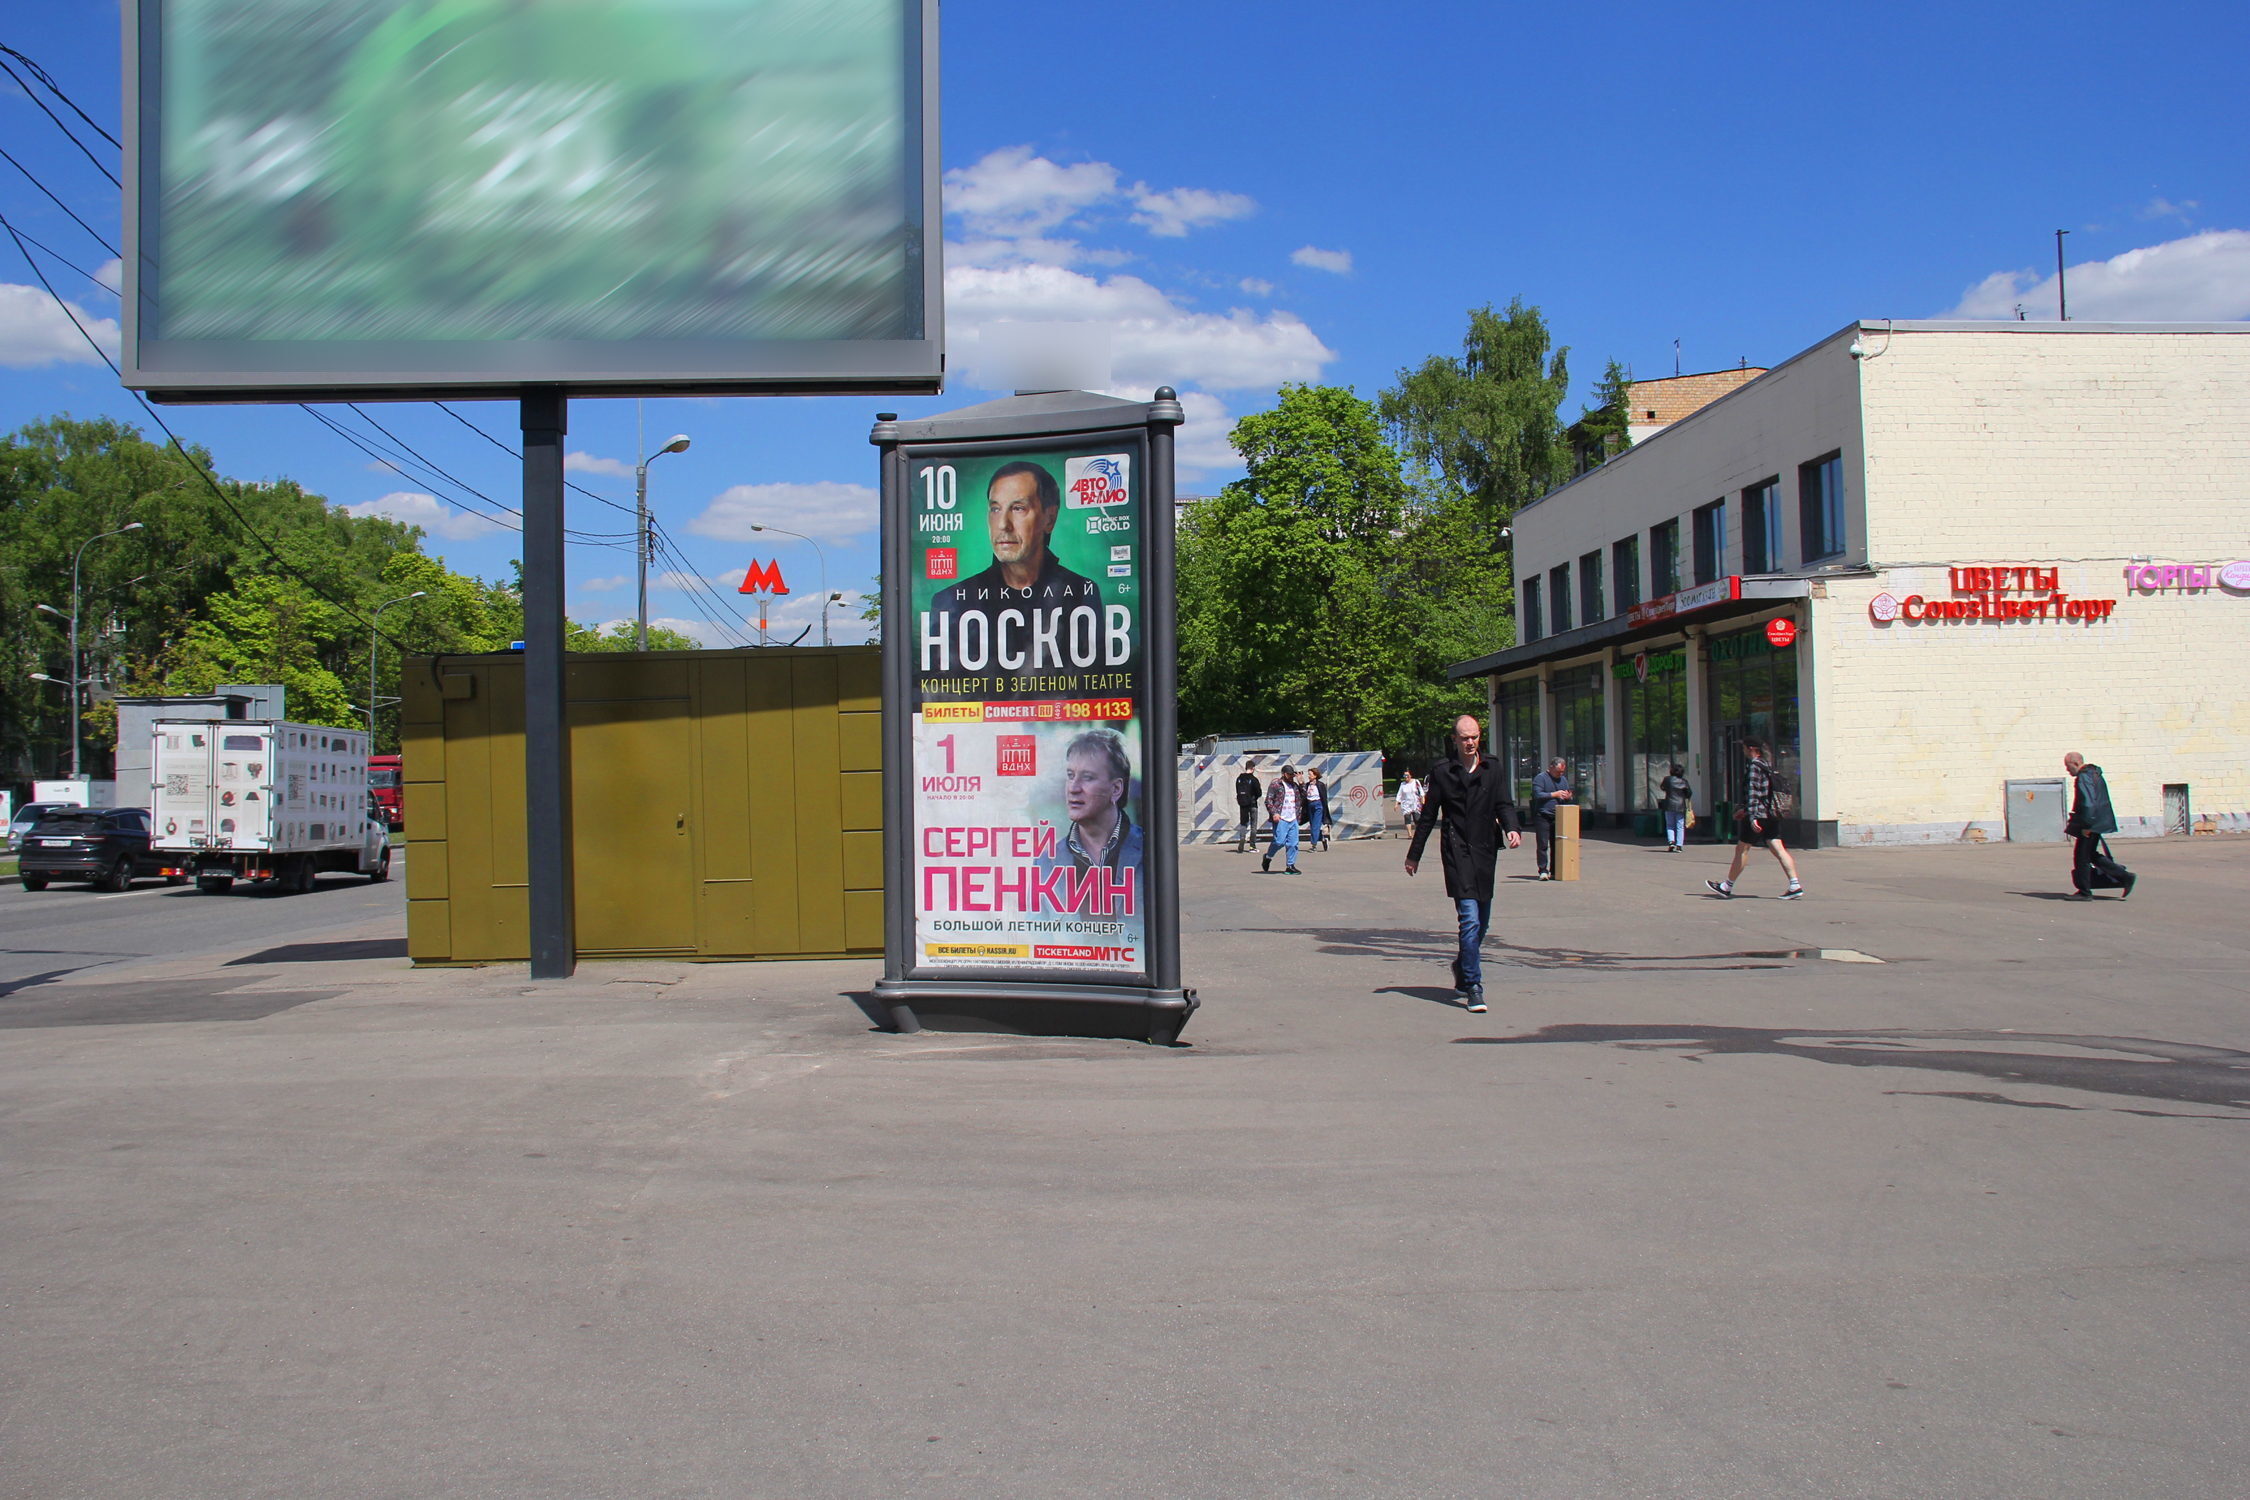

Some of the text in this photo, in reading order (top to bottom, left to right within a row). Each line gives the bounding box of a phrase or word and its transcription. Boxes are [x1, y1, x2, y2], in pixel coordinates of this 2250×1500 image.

[920, 465, 956, 510] 10
[1069, 477, 1107, 492] АВТО
[920, 513, 963, 531] ИЮНЯ
[1102, 521, 1130, 532] GOLD
[932, 535, 951, 544] 20:00
[930, 568, 953, 576] ВДНХ
[1950, 566, 2060, 594] ЦВЕТЫ
[2124, 565, 2211, 588] ТОРТЫ
[956, 580, 1094, 600] НИКОЛАЙ
[1118, 583, 1131, 594] 6+
[1902, 593, 2116, 622] СоюзЦветТорг
[920, 604, 1131, 672] НОСКОВ
[921, 673, 1132, 696] КОНЦЕРТ В ЗЕЛЕНОМ ТЕАТРЕ
[925, 706, 980, 718] БИЛЕТЫ
[1063, 703, 1091, 718] 198
[1094, 702, 1130, 716] 1133
[936, 734, 954, 774] 1
[1002, 763, 1031, 771] ВДНХ
[922, 776, 981, 792] ИЮЛЯ
[923, 820, 1056, 858] СЕРГЕЙ
[924, 866, 1134, 916] ПЕНКИН
[934, 918, 1125, 936] БОЛЬШОЙ ЛЕТНИЙ КОНЦЕРТ
[1128, 934, 1139, 943] 6+
[938, 946, 976, 954] ВСЕ БИЛЕТЫ
[1036, 947, 1092, 957] TICKETLAND
